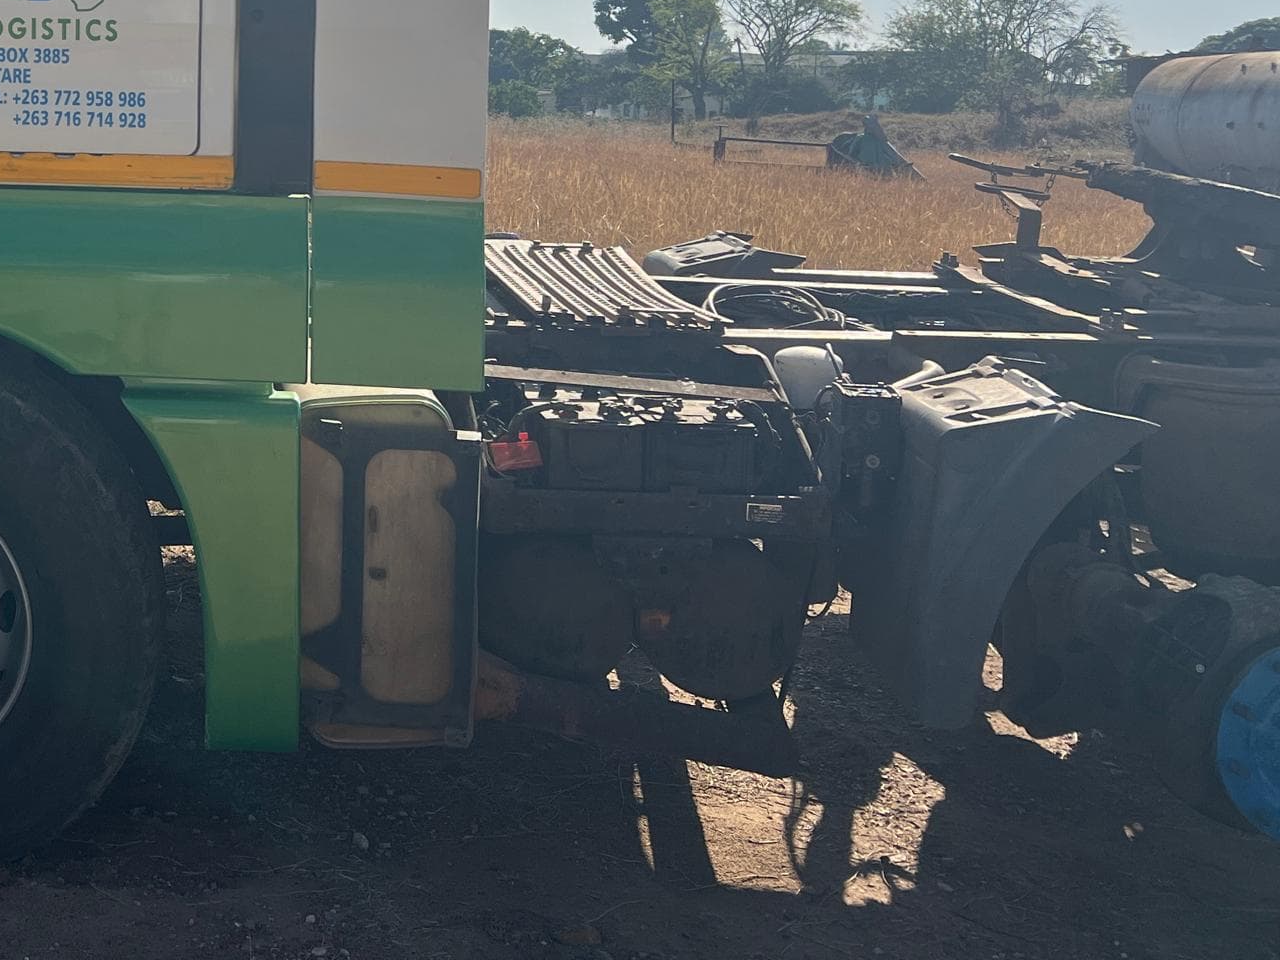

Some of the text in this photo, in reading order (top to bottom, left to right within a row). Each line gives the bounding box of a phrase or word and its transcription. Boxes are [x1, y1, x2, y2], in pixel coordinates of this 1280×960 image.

[33, 48, 70, 65] 3885
[12, 89, 49, 106] +263
[54, 90, 81, 106] 772
[86, 91, 114, 107] 958
[118, 92, 146, 108] 986
[12, 110, 147, 129] +263 716 714 928
